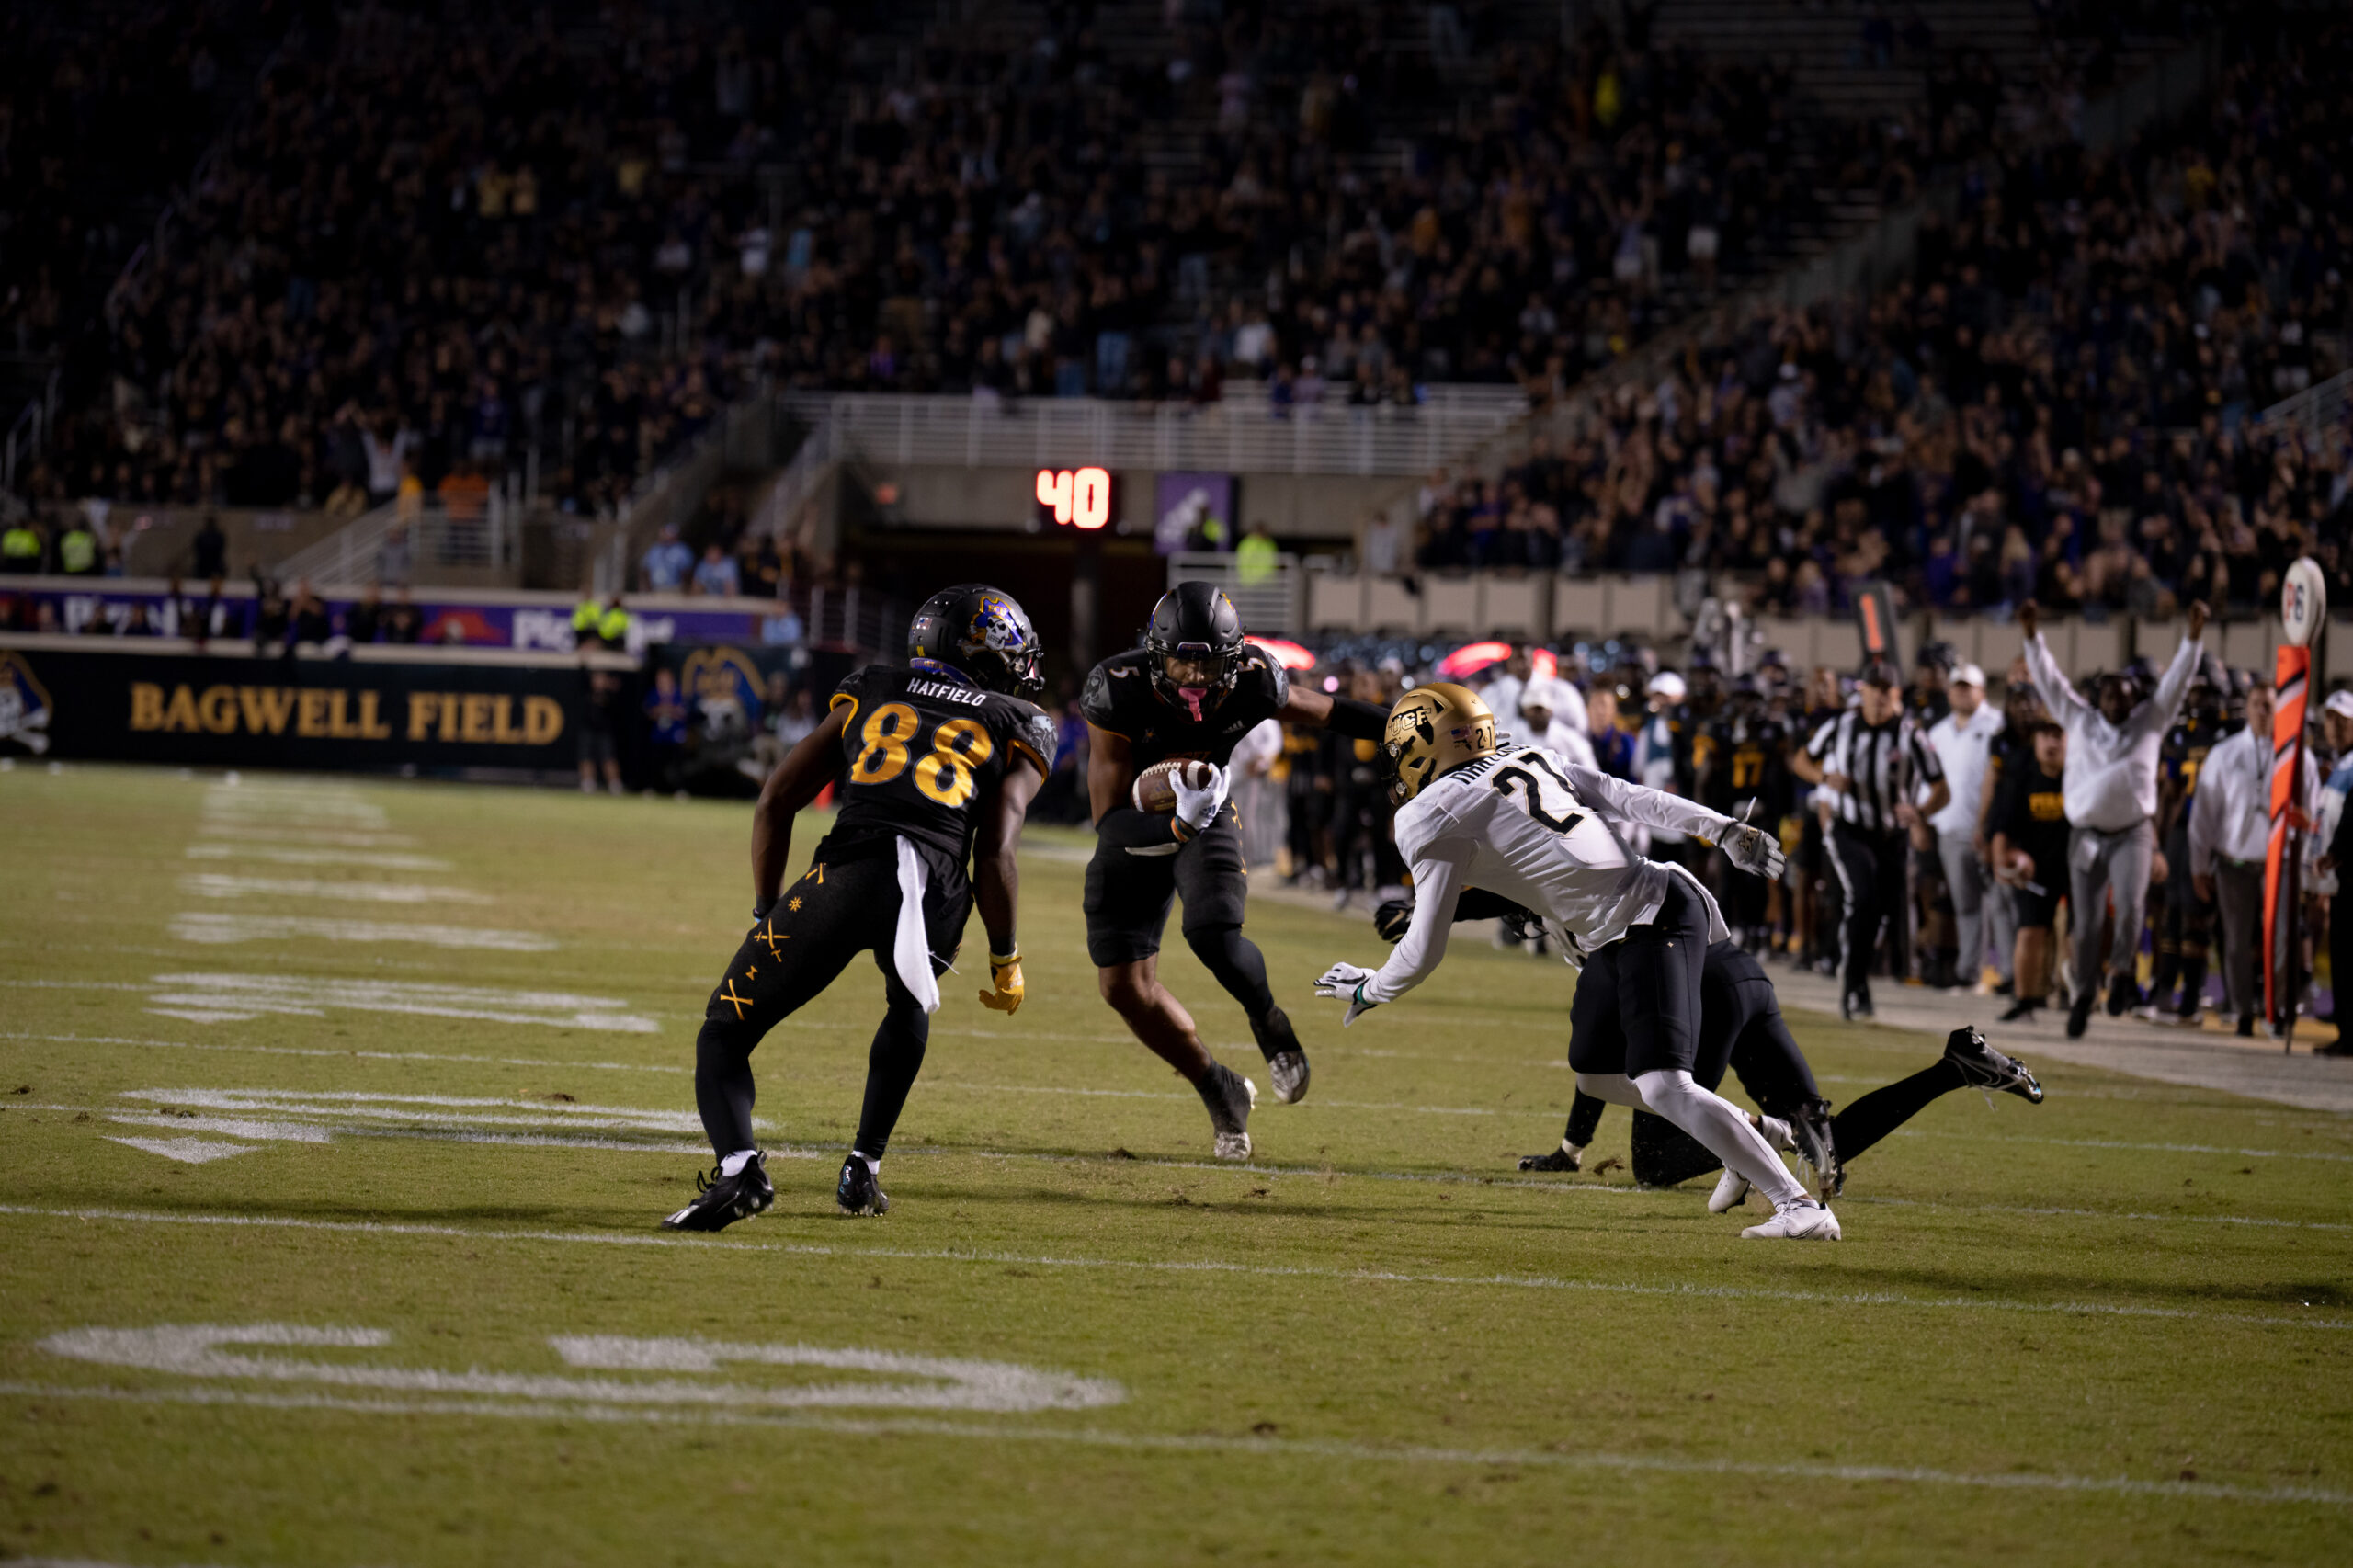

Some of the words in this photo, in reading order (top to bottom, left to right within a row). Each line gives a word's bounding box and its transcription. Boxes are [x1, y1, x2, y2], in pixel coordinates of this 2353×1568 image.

[1036, 467, 1110, 528] 40
[128, 680, 392, 740] BAGWELL
[405, 690, 564, 745] FIELD
[906, 676, 987, 707] HATFIELD
[1389, 707, 1432, 736] UCF
[1475, 726, 1493, 749] 21
[850, 701, 994, 809] 88
